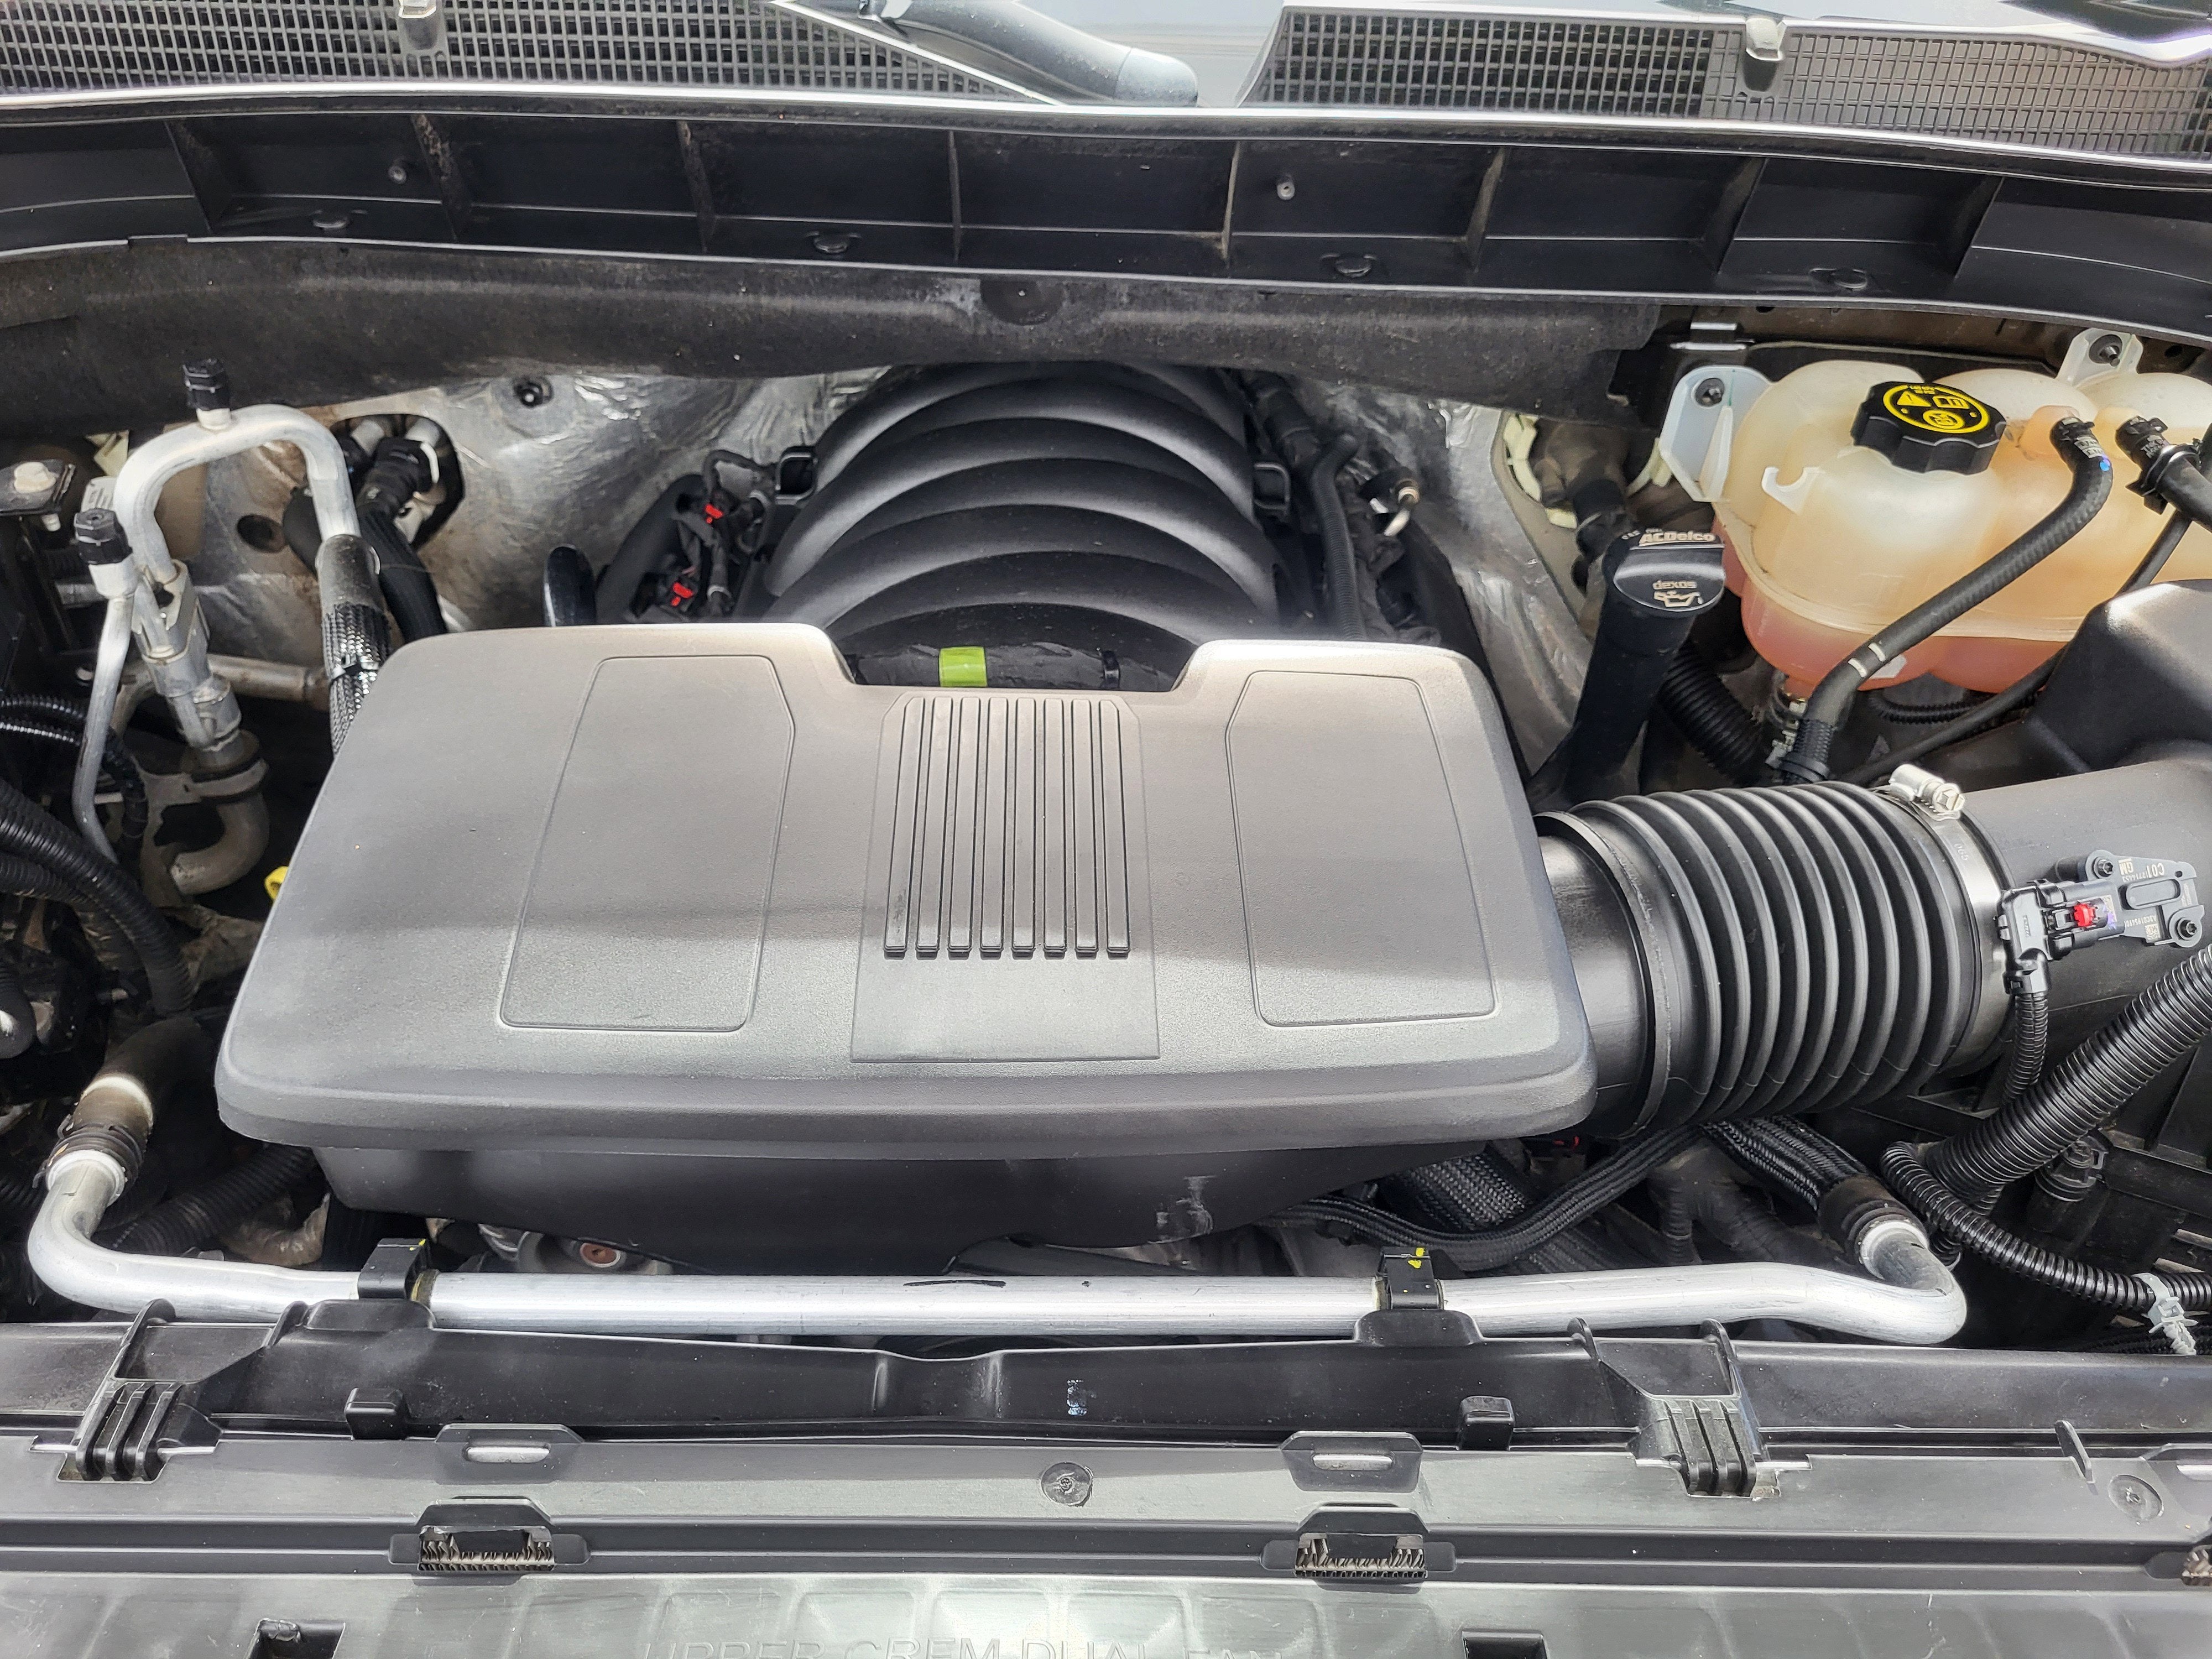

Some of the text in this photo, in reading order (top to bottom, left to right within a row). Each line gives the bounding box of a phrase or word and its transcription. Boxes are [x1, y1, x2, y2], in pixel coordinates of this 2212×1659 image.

[1639, 530, 1715, 545] ACDelco
[1652, 580, 1698, 590] dexos
[2119, 860, 2133, 875] GM
[2146, 863, 2164, 878] C01
